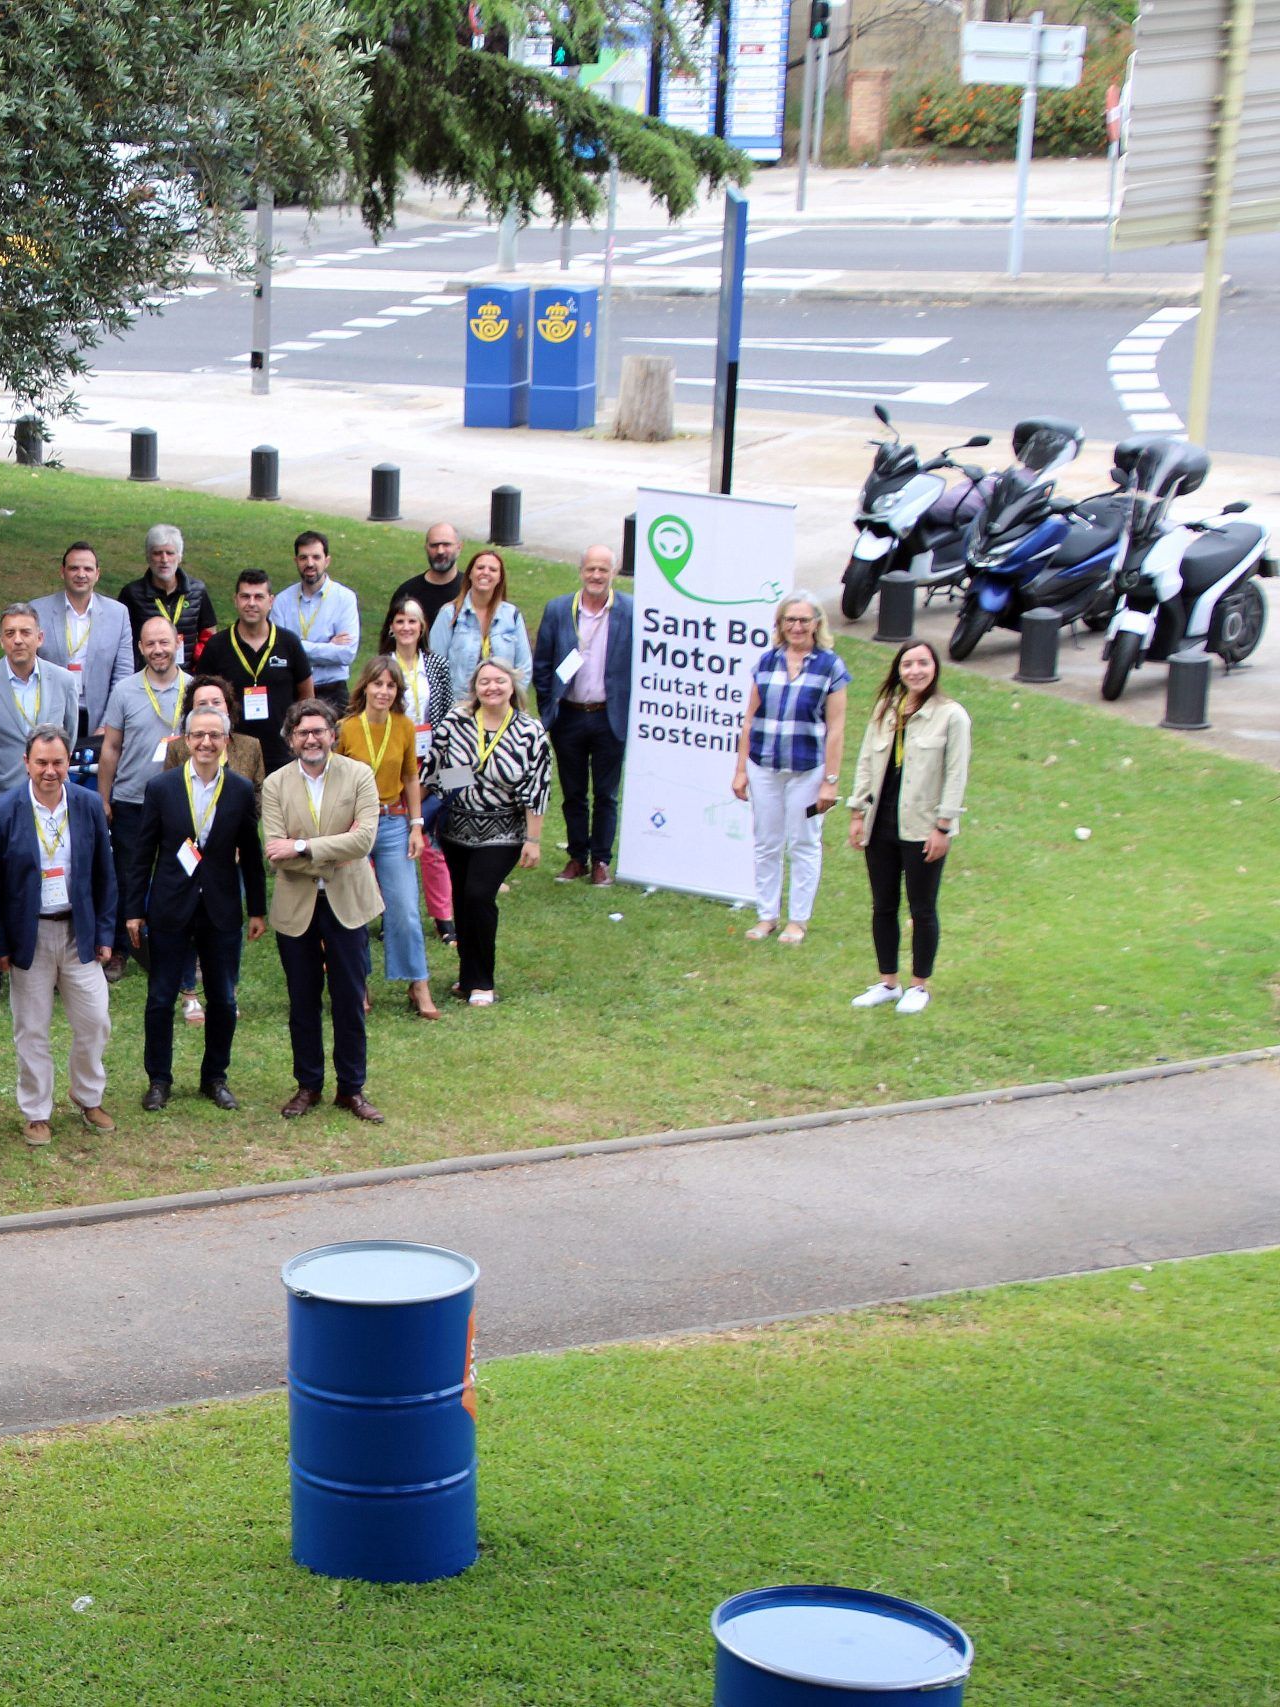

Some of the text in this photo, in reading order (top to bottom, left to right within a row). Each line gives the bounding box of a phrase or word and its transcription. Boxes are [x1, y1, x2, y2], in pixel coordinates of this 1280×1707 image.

[643, 607, 769, 648] Sant Bo
[641, 639, 743, 676] Motor
[640, 672, 743, 703] ciutat de
[639, 700, 745, 728] mobilitat
